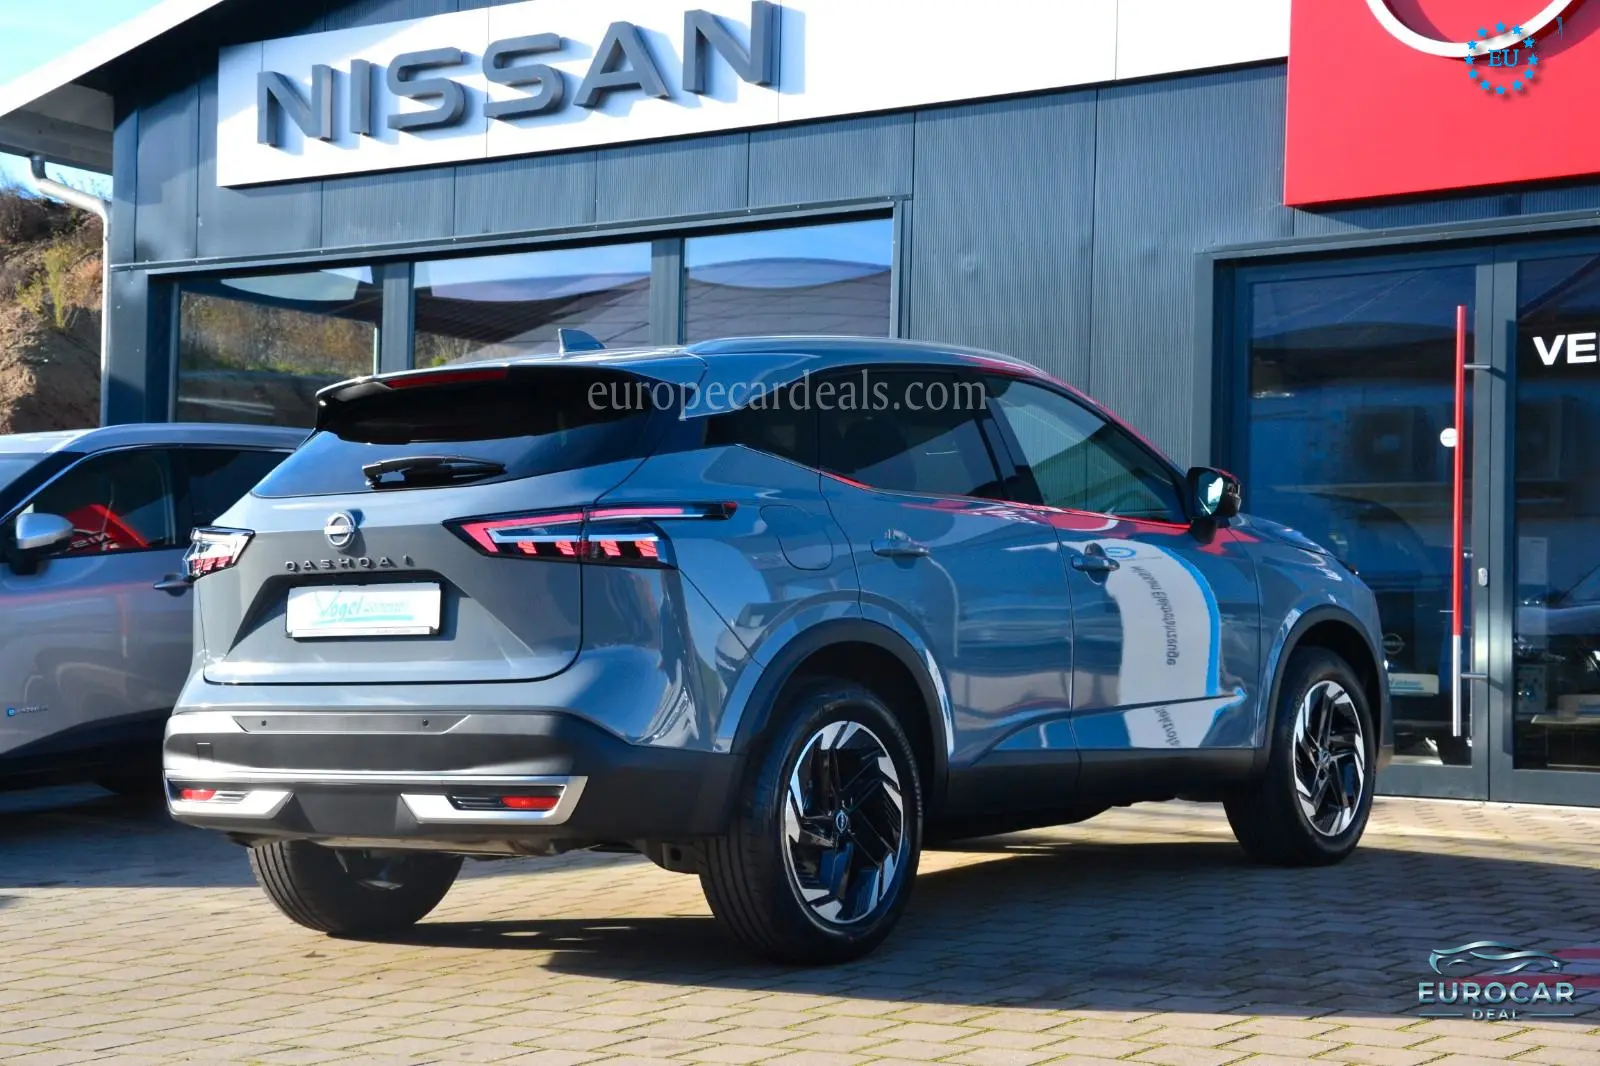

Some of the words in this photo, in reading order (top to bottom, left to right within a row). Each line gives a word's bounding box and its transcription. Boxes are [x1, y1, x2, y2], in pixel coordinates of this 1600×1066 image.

[257, 0, 783, 146] NISSAN
[1532, 331, 1600, 366] VE
[284, 553, 415, 573] QASHQAI
